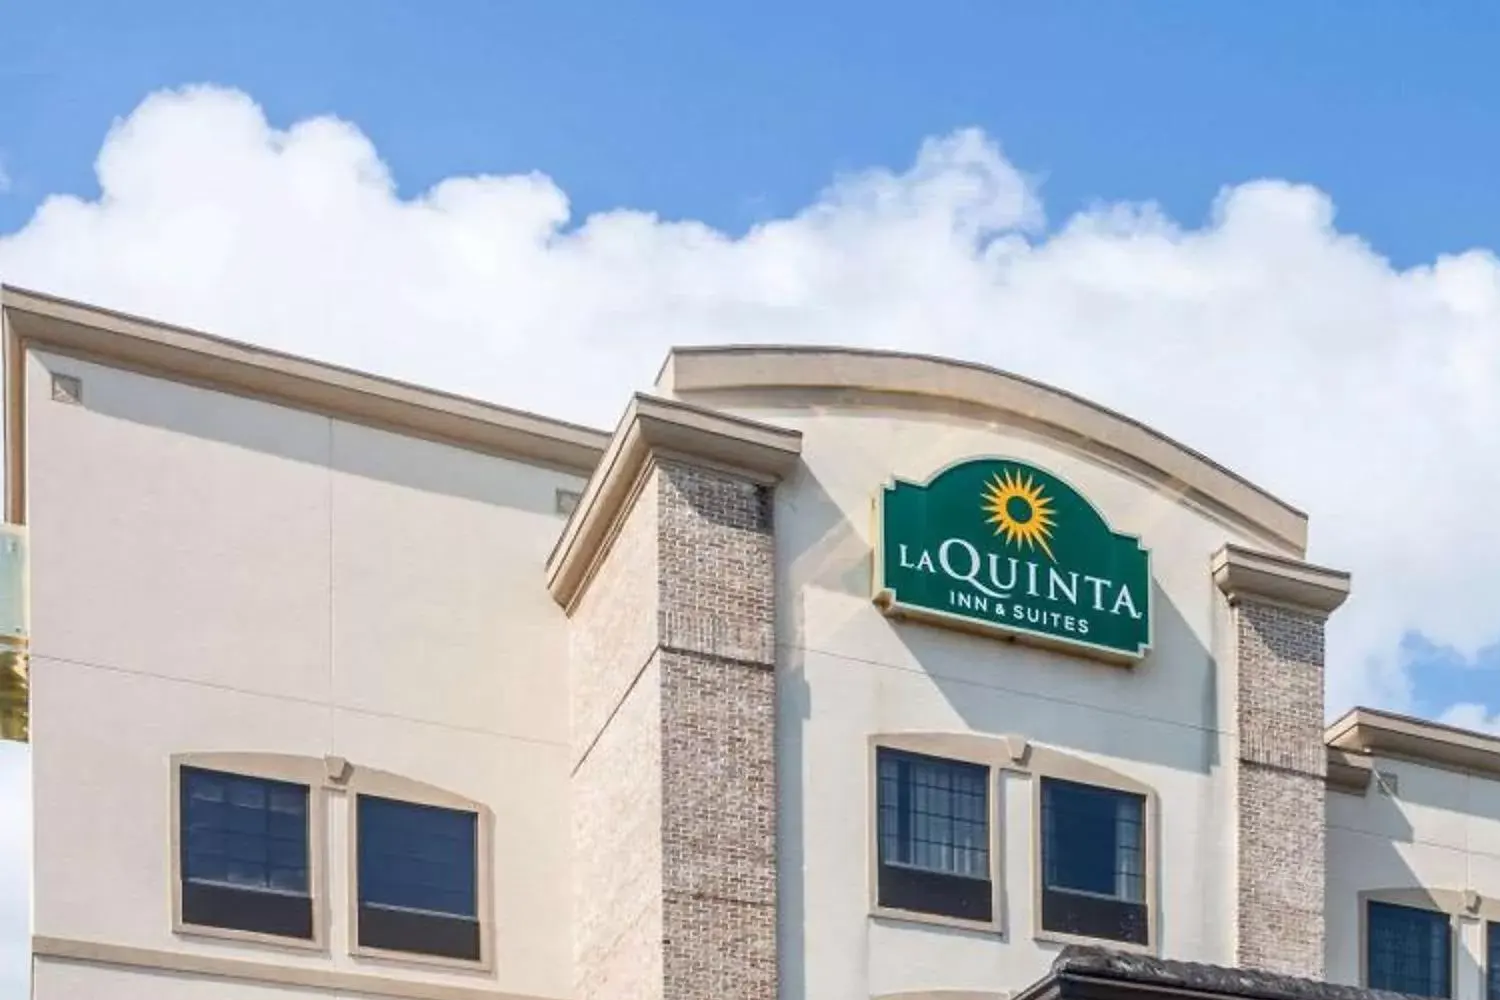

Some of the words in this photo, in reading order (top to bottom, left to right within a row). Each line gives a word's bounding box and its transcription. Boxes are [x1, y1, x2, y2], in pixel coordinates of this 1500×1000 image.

[899, 544, 936, 574] LA
[938, 538, 1143, 619] QUINTA
[950, 590, 988, 613] INN
[995, 602, 1006, 617] &
[1013, 604, 1090, 634] SUITES
